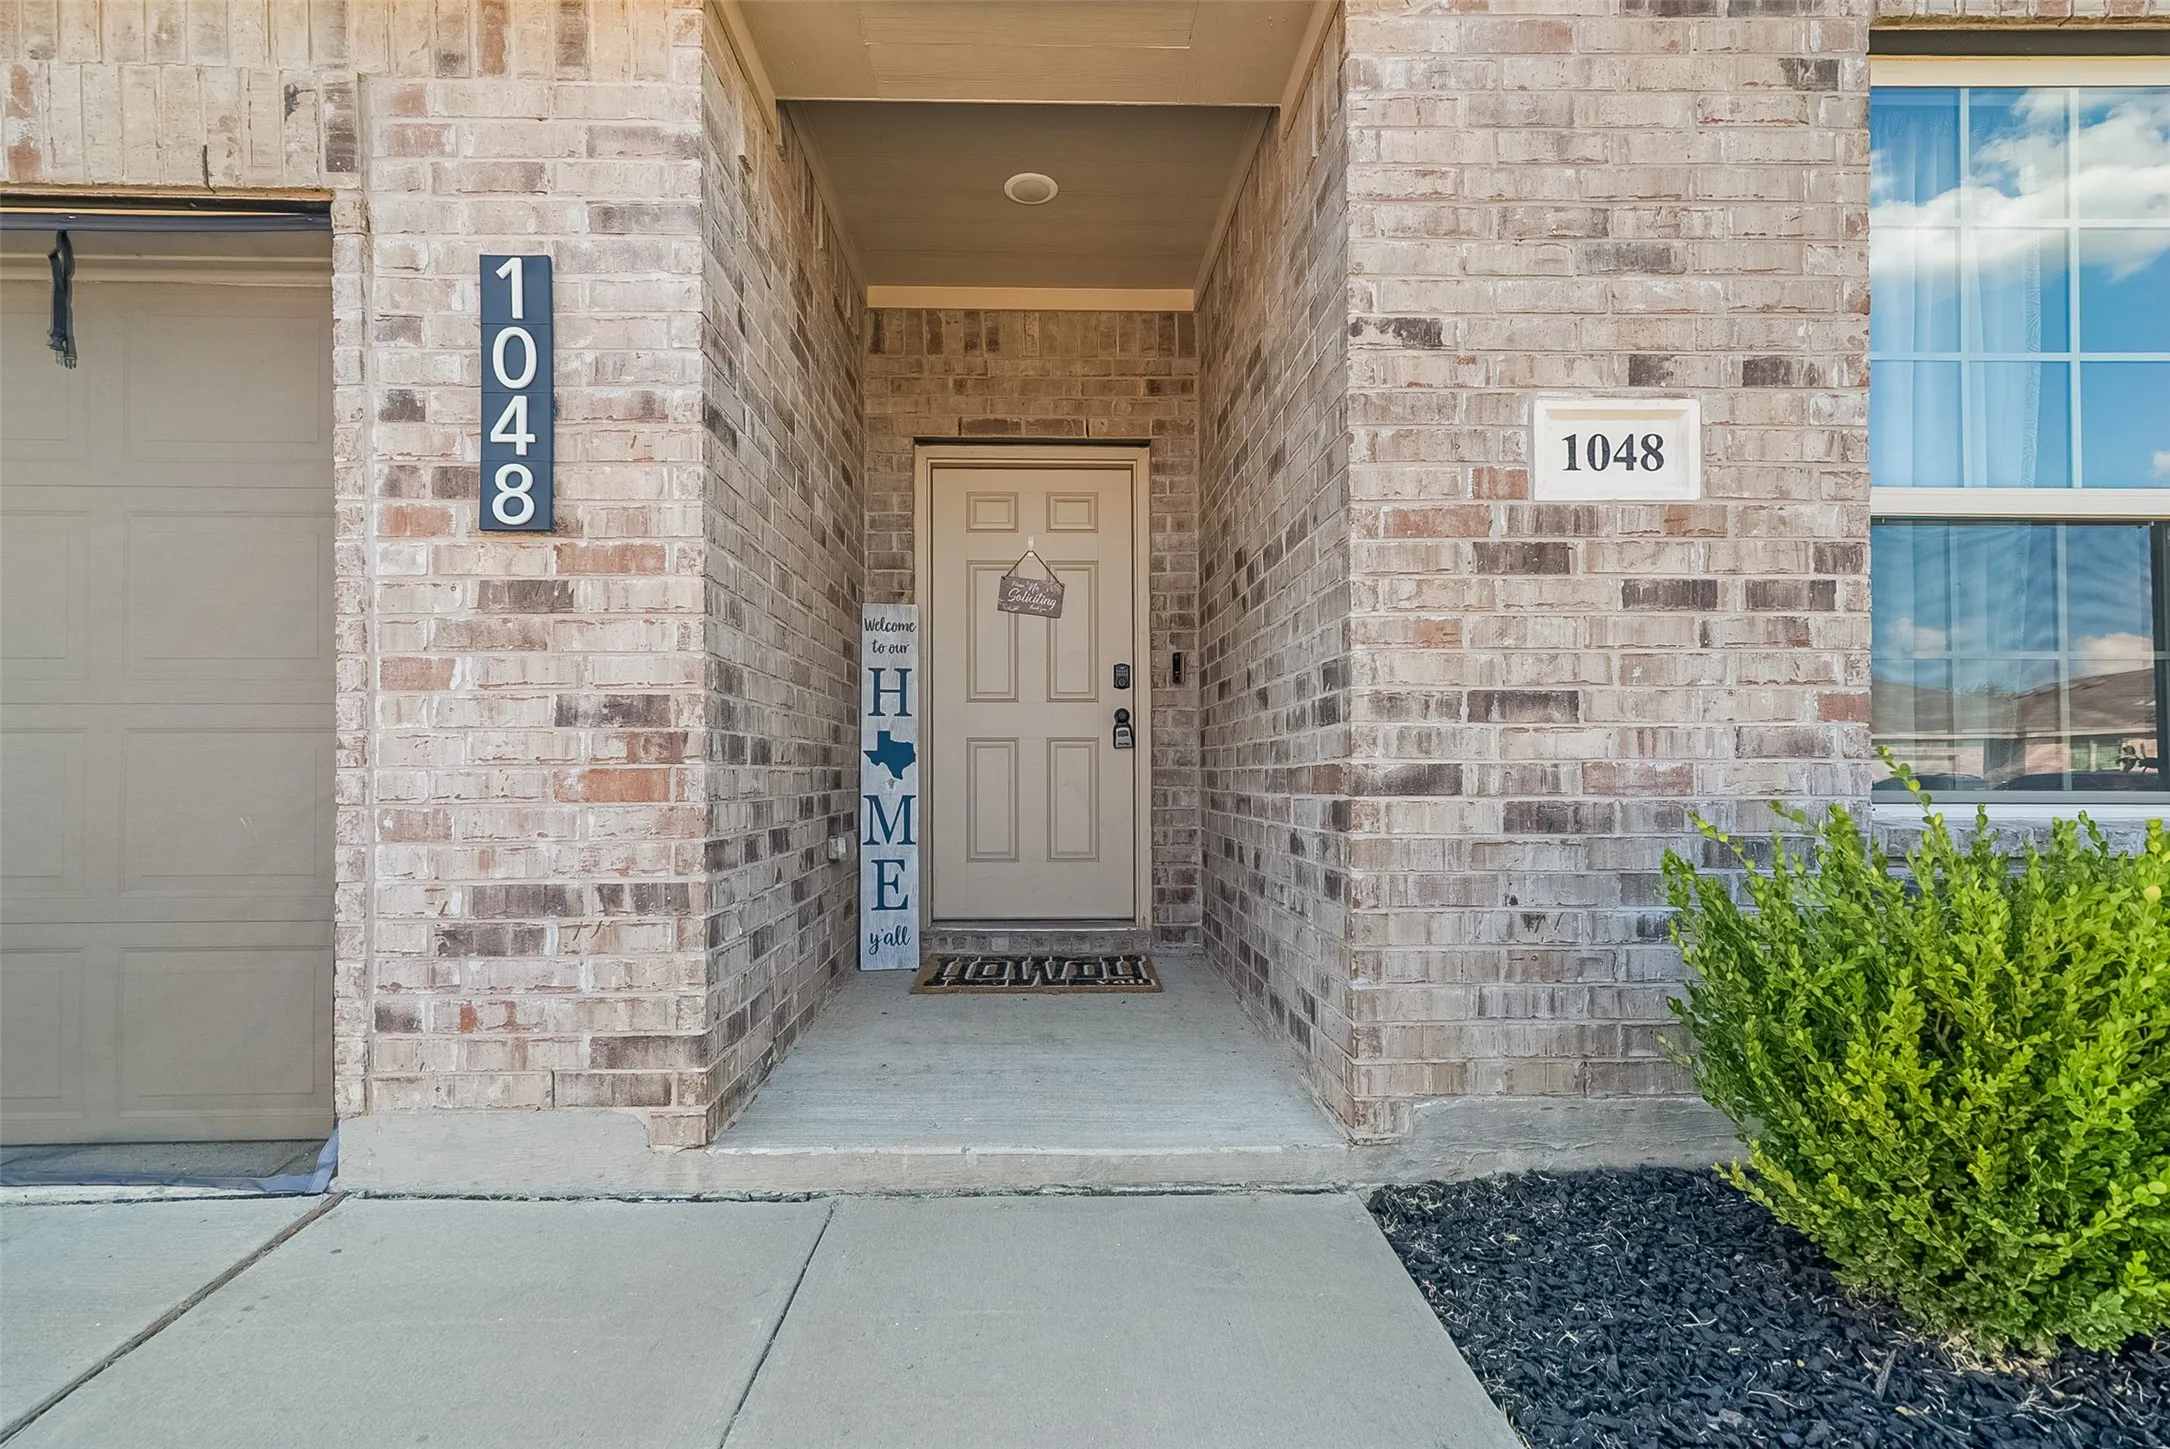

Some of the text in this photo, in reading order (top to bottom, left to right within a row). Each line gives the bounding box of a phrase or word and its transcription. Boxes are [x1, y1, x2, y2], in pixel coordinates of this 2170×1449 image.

[490, 256, 538, 526] 1048
[1562, 433, 1665, 472] 1048
[1007, 587, 1057, 610] Soliciting
[1028, 583, 1040, 594] No
[864, 617, 917, 633] Welcome
[871, 638, 910, 654] to our
[868, 924, 912, 955] y'all
